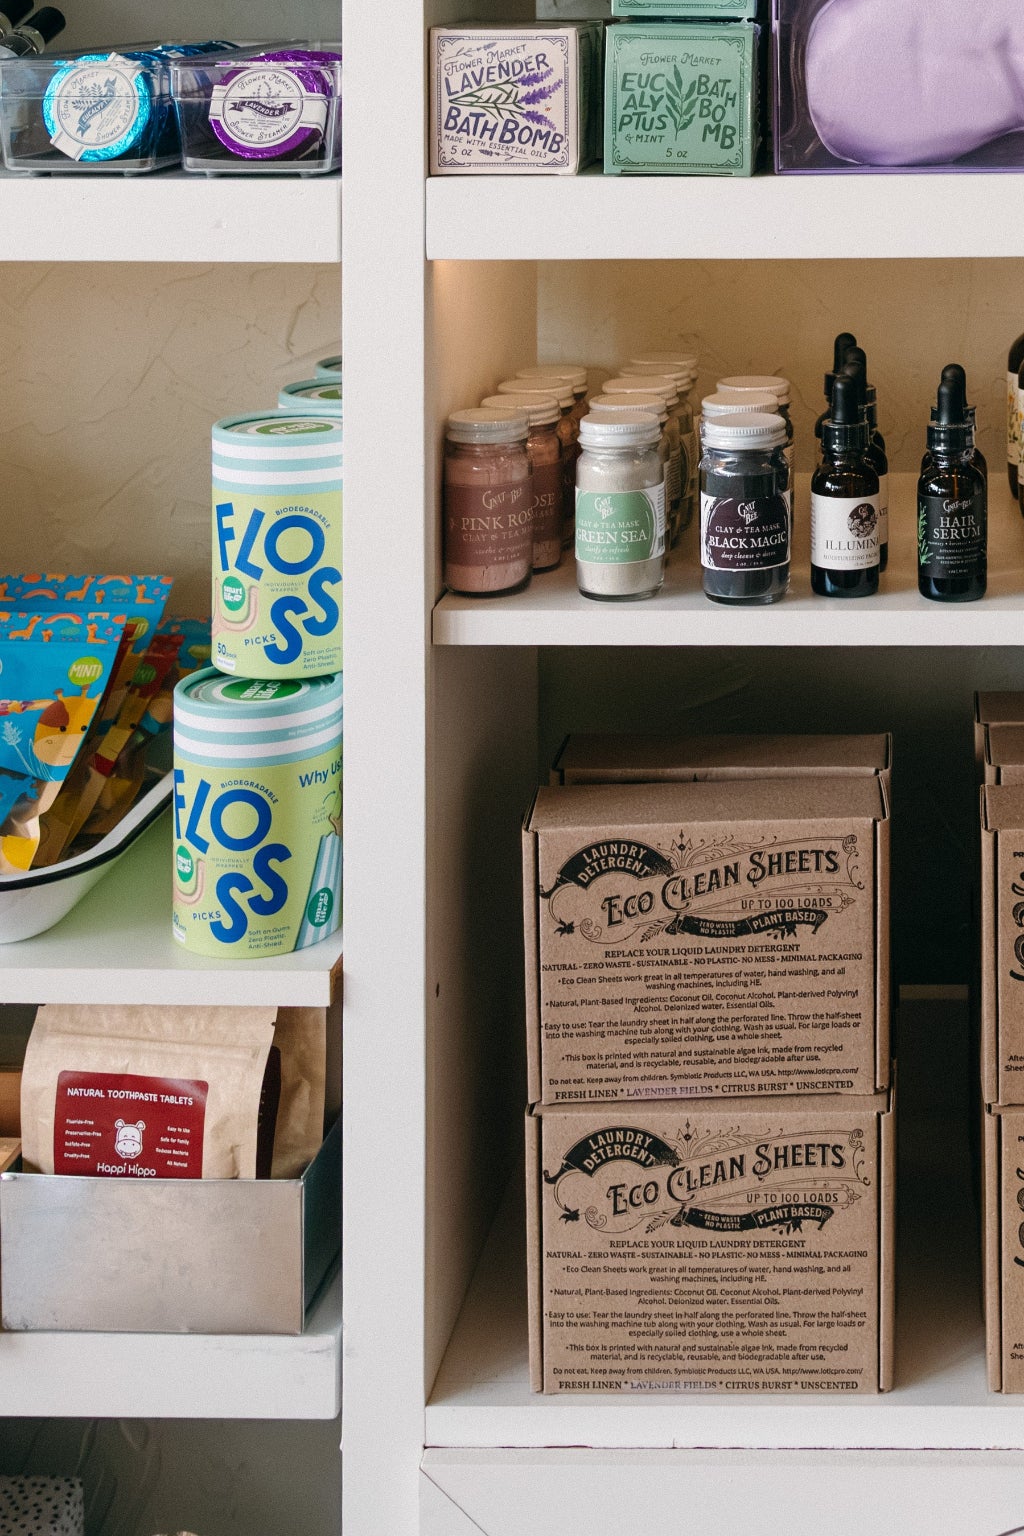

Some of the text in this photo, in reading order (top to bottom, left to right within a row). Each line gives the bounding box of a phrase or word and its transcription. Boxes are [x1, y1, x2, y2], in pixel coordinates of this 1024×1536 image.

[444, 44, 527, 76] FLOWER MARKET
[444, 53, 549, 97] LAVENDER
[444, 106, 564, 154] BATH BOMB
[444, 134, 548, 159] MADE WITH ESSENTIAL OILS
[450, 146, 457, 155] 5
[275, 506, 331, 529] BIODEGRADABLE
[939, 515, 976, 528] HAIR
[576, 529, 648, 544] GREEN SEA
[715, 525, 734, 534] CLAY
[744, 525, 761, 534] TEA
[762, 522, 781, 533] MASK
[932, 526, 981, 540] SERUM
[708, 532, 787, 549] BLACK MAGIC
[244, 633, 277, 646] PICKS
[582, 843, 645, 865] LAUNDRY
[577, 859, 649, 884] DETERGENT
[601, 849, 841, 928] ECO CLEAN SHEETS
[741, 897, 833, 910] UP TO 100 LOADS
[752, 911, 817, 930] PLANT BASED
[604, 944, 801, 958] REPLACE YOUR LIQUID LAUNDRY DETERGENT
[67, 1087, 194, 1106] NATURAL TOOTHPASTE TABLETS
[97, 1162, 157, 1177] Happi Hippo
[606, 1143, 846, 1216] ECO CLEAN SHEETS
